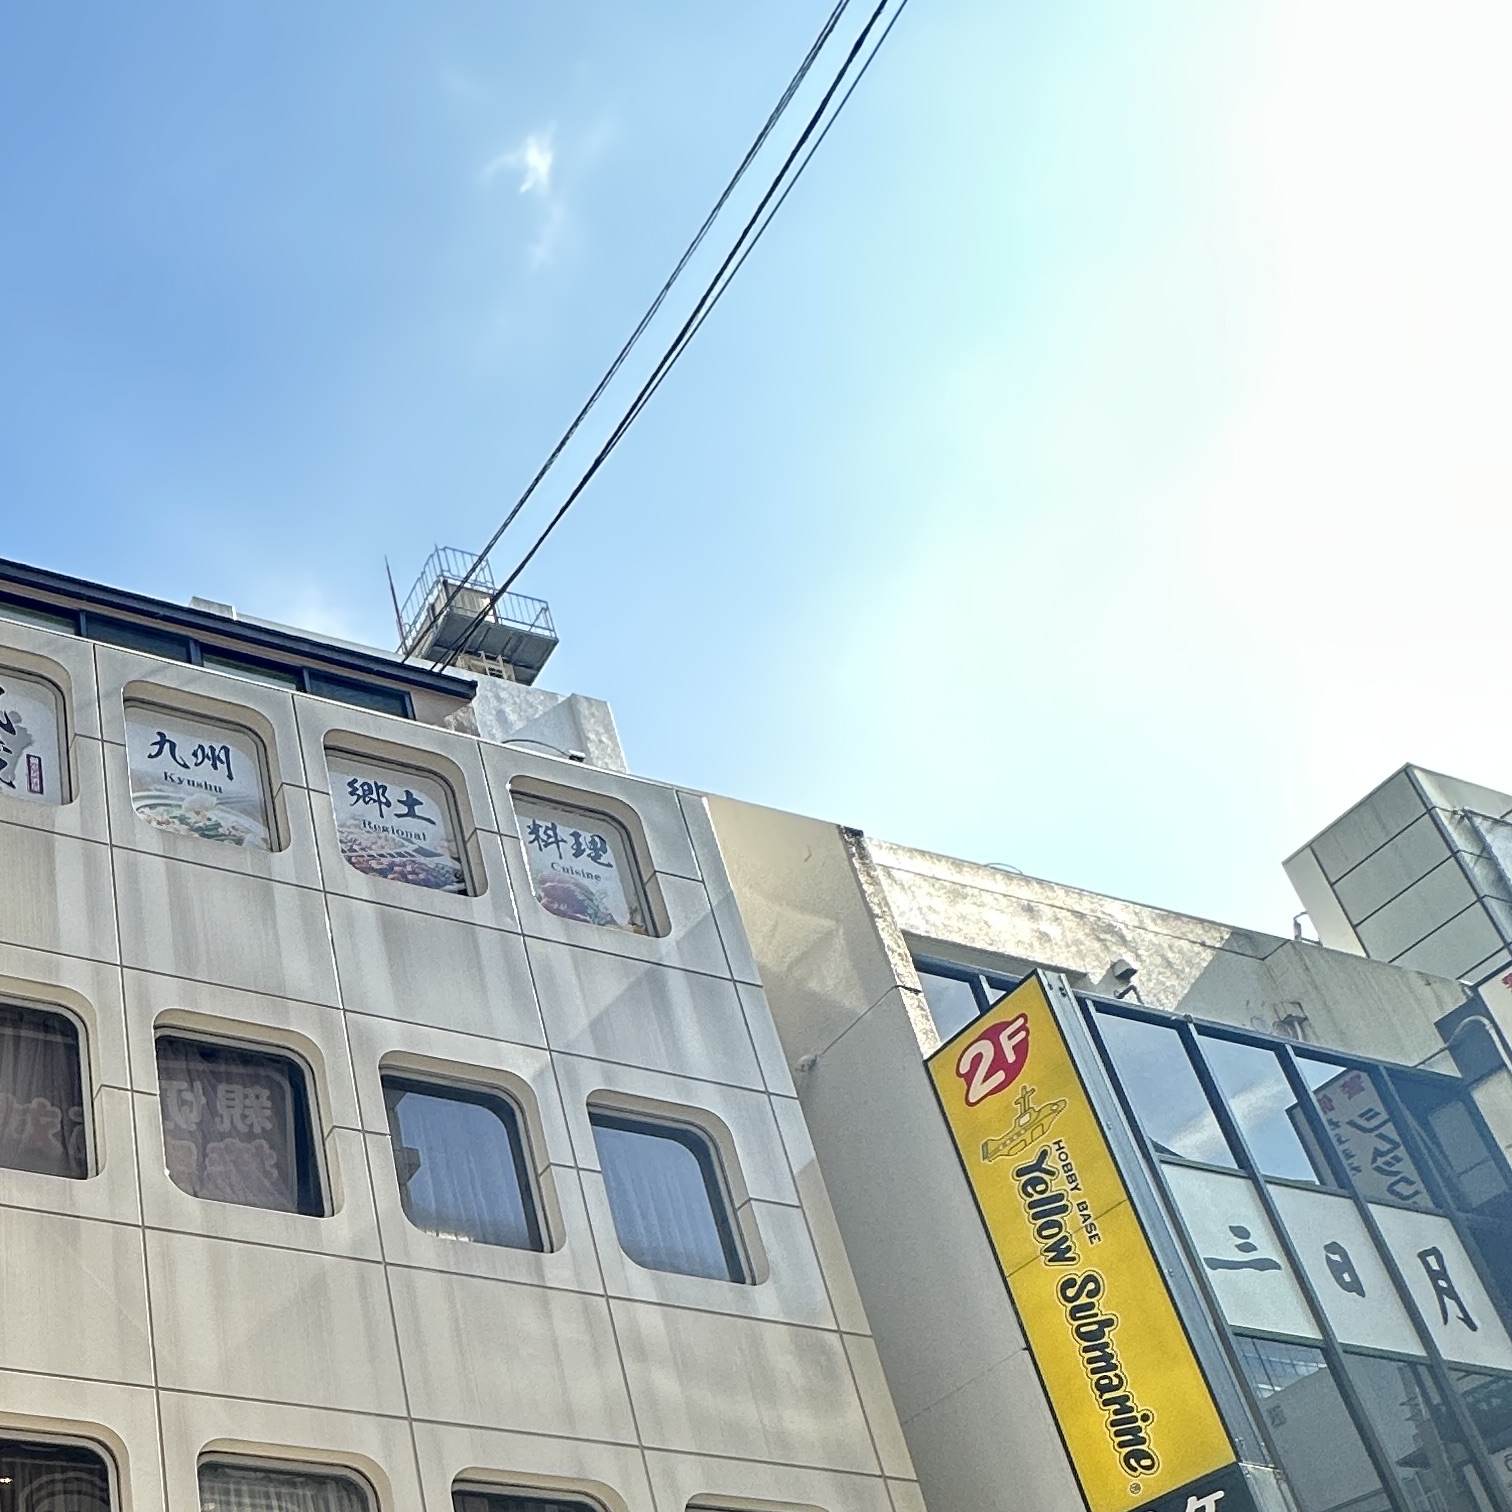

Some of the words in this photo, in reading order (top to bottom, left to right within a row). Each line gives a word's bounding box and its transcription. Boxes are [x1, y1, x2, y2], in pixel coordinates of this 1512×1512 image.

[146, 730, 234, 783] 九州
[162, 768, 224, 796] Kyushu
[345, 775, 438, 827] 郷土
[360, 817, 428, 844] Regional
[525, 819, 615, 869] 料理
[549, 859, 602, 884] Cuisine
[955, 1012, 1031, 1108] 2F
[1051, 1138, 1083, 1193] HOBBY
[1076, 1199, 1103, 1246] BASE
[1009, 1146, 1082, 1267] Yellow
[1055, 1271, 1162, 1479] Submarine
